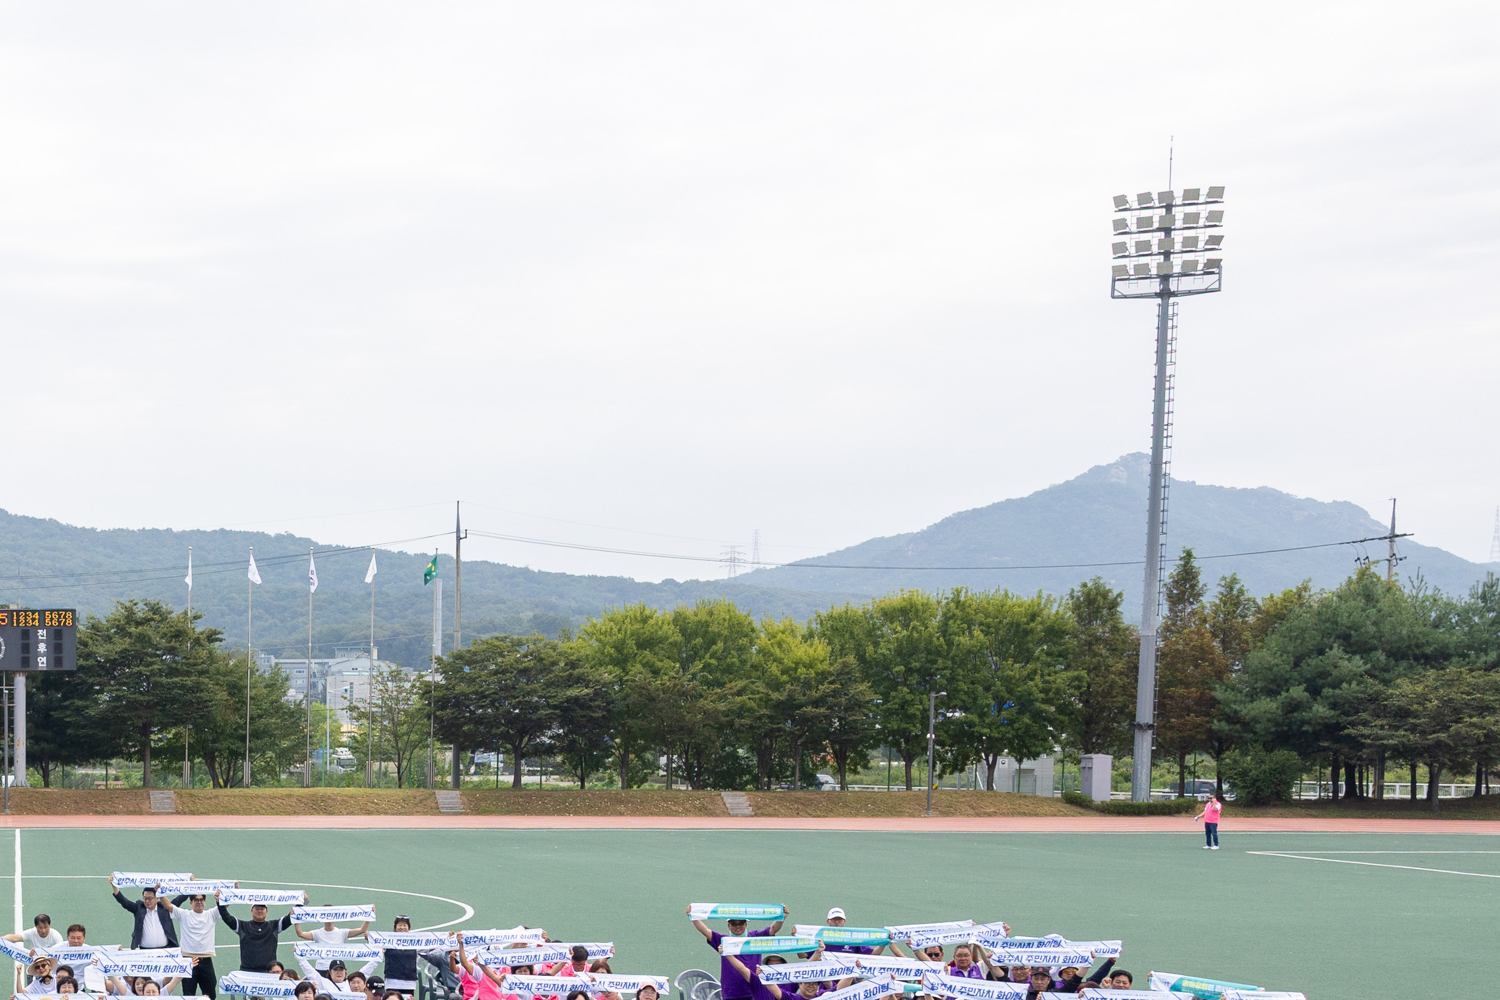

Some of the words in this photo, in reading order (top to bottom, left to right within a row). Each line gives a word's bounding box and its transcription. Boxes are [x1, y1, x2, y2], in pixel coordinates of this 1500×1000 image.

[12, 611, 39, 619] 1234
[45, 611, 73, 619] 5678
[12, 619, 39, 627] 1234
[45, 619, 73, 627] 5678
[37, 629, 47, 640] 전
[37, 642, 47, 653] 후
[37, 656, 47, 667] 연
[104, 964, 127, 974] 양주시
[129, 964, 161, 973] 주민자치
[162, 964, 187, 974] 화이팅
[863, 981, 890, 999] 화이팅
